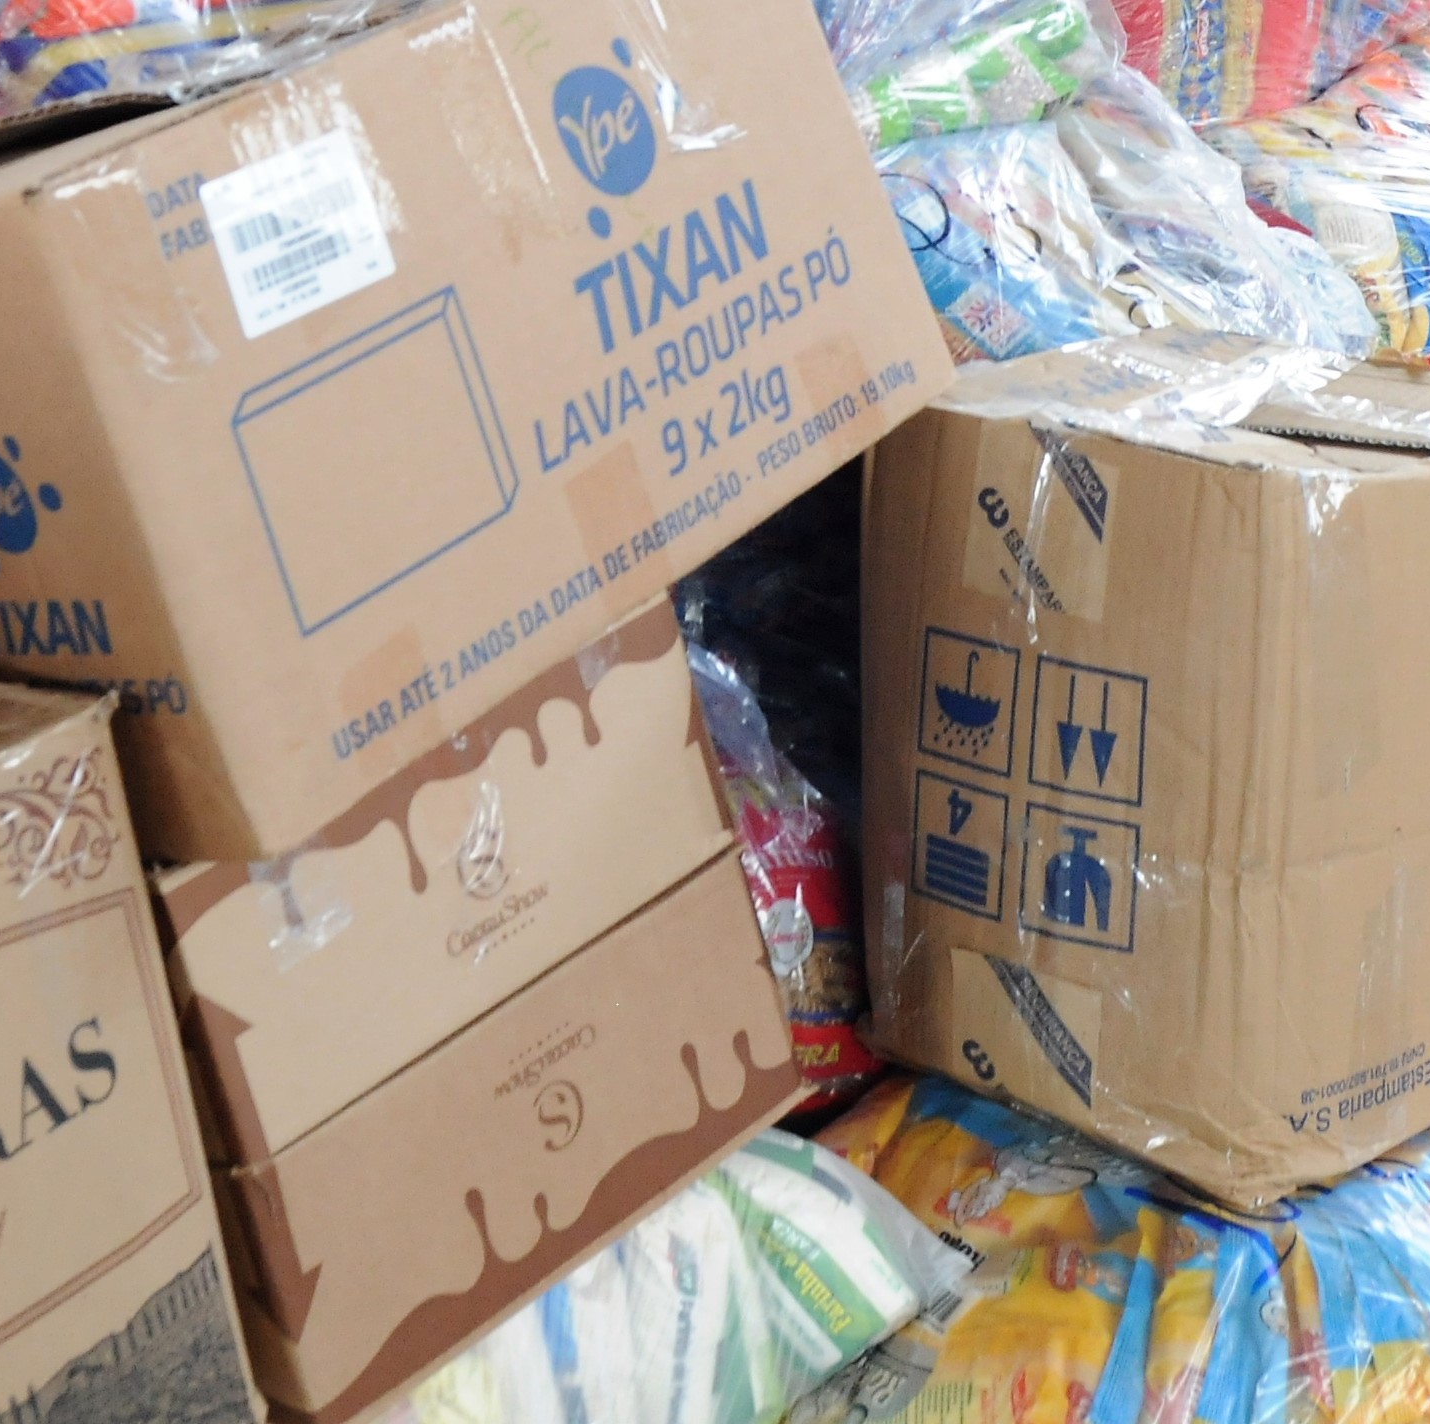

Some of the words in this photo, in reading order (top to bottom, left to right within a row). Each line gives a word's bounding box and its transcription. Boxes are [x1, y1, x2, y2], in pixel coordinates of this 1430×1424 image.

[557, 91, 641, 180] Ypê
[160, 217, 214, 262] FAB
[574, 179, 770, 354] TIXAN
[532, 265, 803, 473] LAVA-ROUPAS
[803, 228, 852, 303] PÓ
[662, 417, 689, 476] 9
[698, 408, 721, 450] x
[719, 364, 792, 440] 2kg
[332, 693, 397, 761] USAR
[399, 660, 439, 721] ATÉ
[440, 657, 458, 692] 2
[458, 622, 516, 682] ANOS
[519, 601, 550, 644] DA
[550, 566, 604, 627] DATA
[606, 547, 631, 582] DE
[632, 472, 743, 571] FABRICAÇÃO
[756, 425, 800, 478] PESO
[802, 392, 862, 452] BRUTO:
